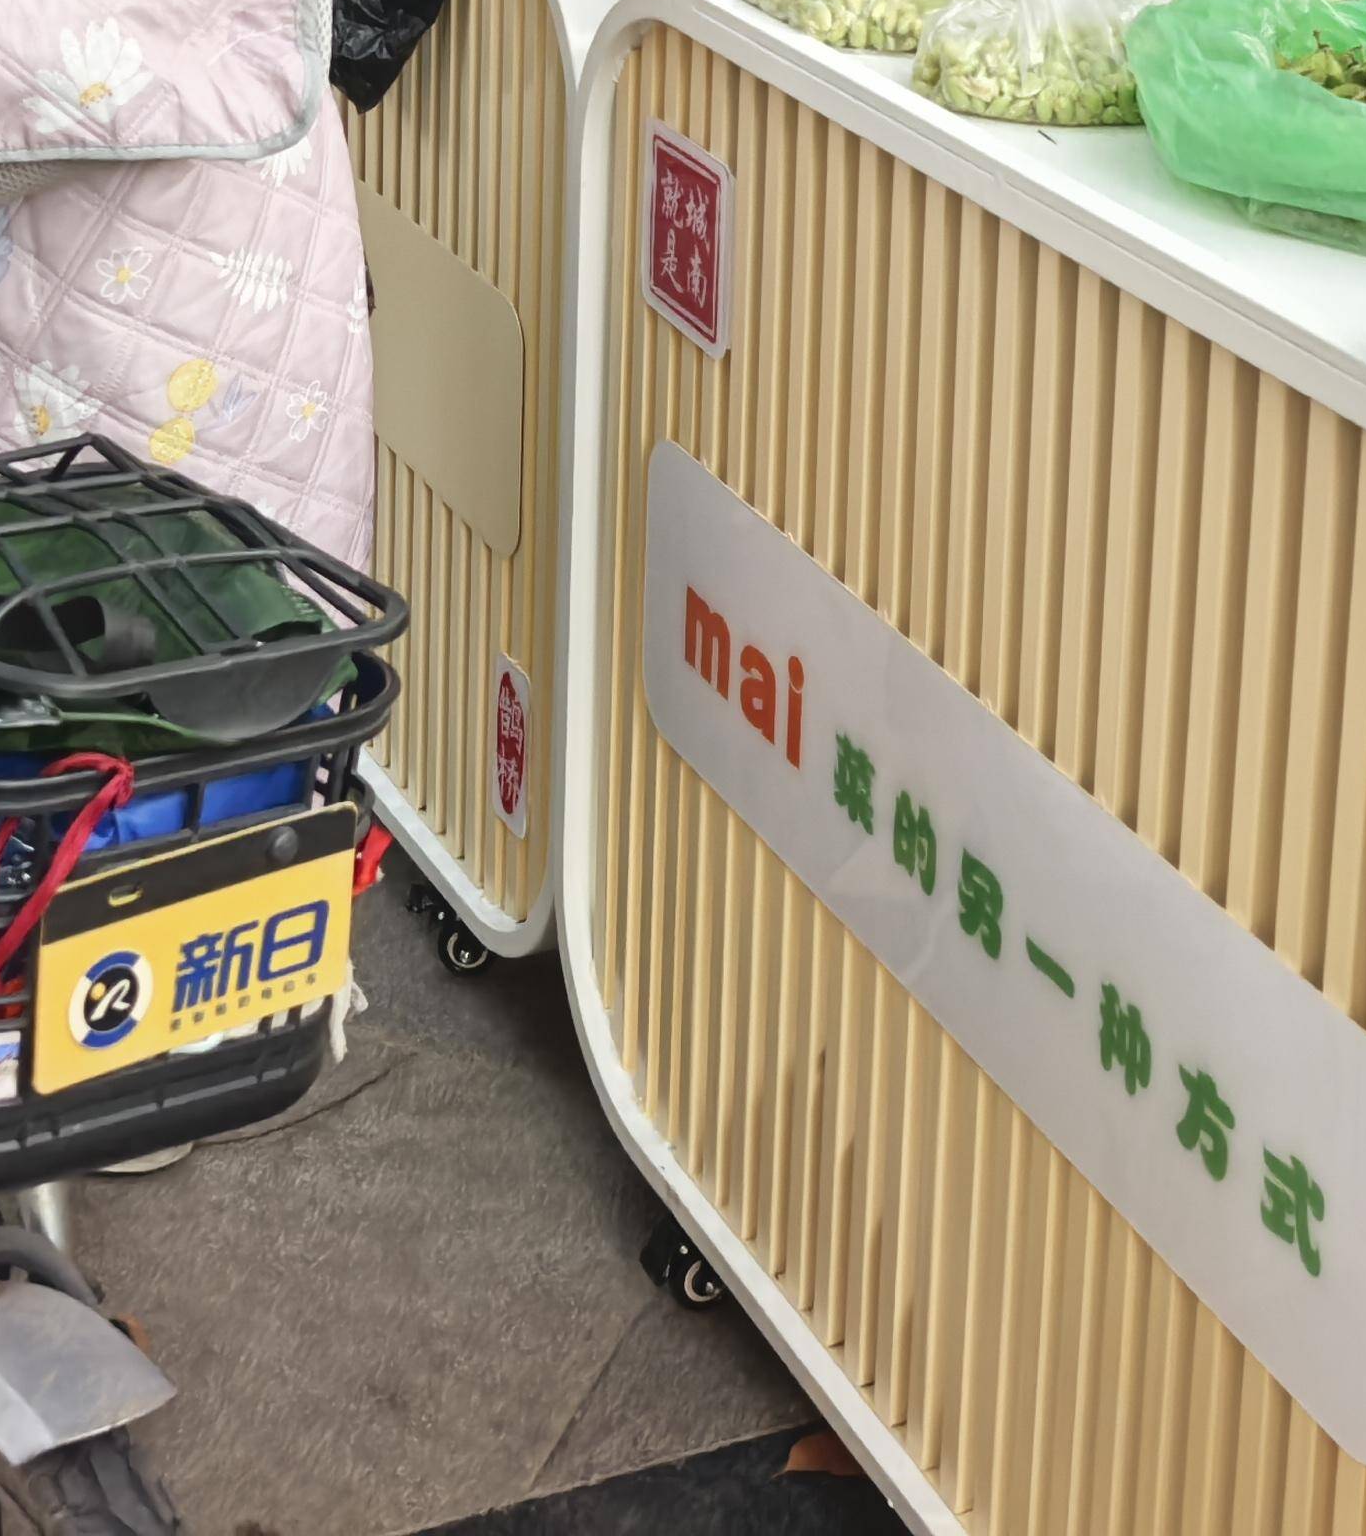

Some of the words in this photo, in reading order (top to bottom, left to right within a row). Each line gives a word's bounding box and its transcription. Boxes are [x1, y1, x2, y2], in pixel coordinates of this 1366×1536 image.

[171, 899, 330, 1014] 新日
[684, 583, 806, 770] mai
[833, 731, 1327, 1278] 菜的另一种方式
